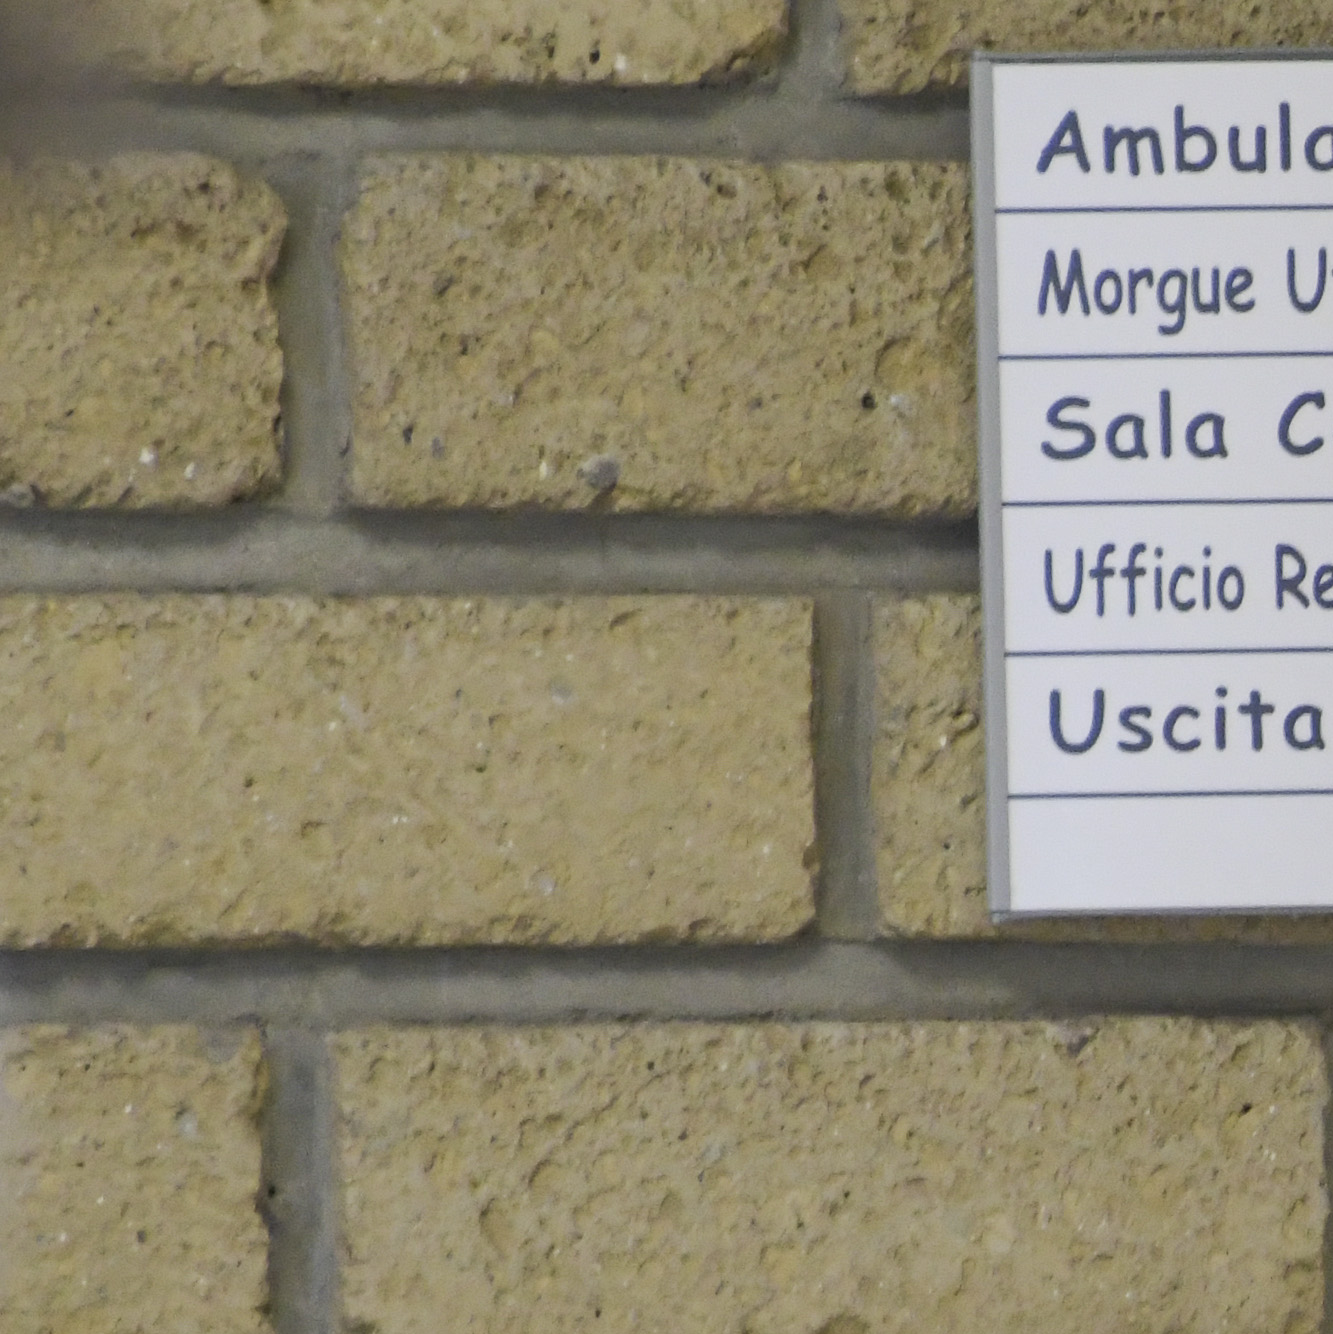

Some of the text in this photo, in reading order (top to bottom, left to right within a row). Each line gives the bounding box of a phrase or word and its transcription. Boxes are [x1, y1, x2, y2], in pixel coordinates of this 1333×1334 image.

[1037, 248, 1256, 337] Morgue
[1040, 388, 1229, 462] Sala
[1043, 542, 1246, 618] Ufficio
[1049, 686, 1326, 756] Uscita
